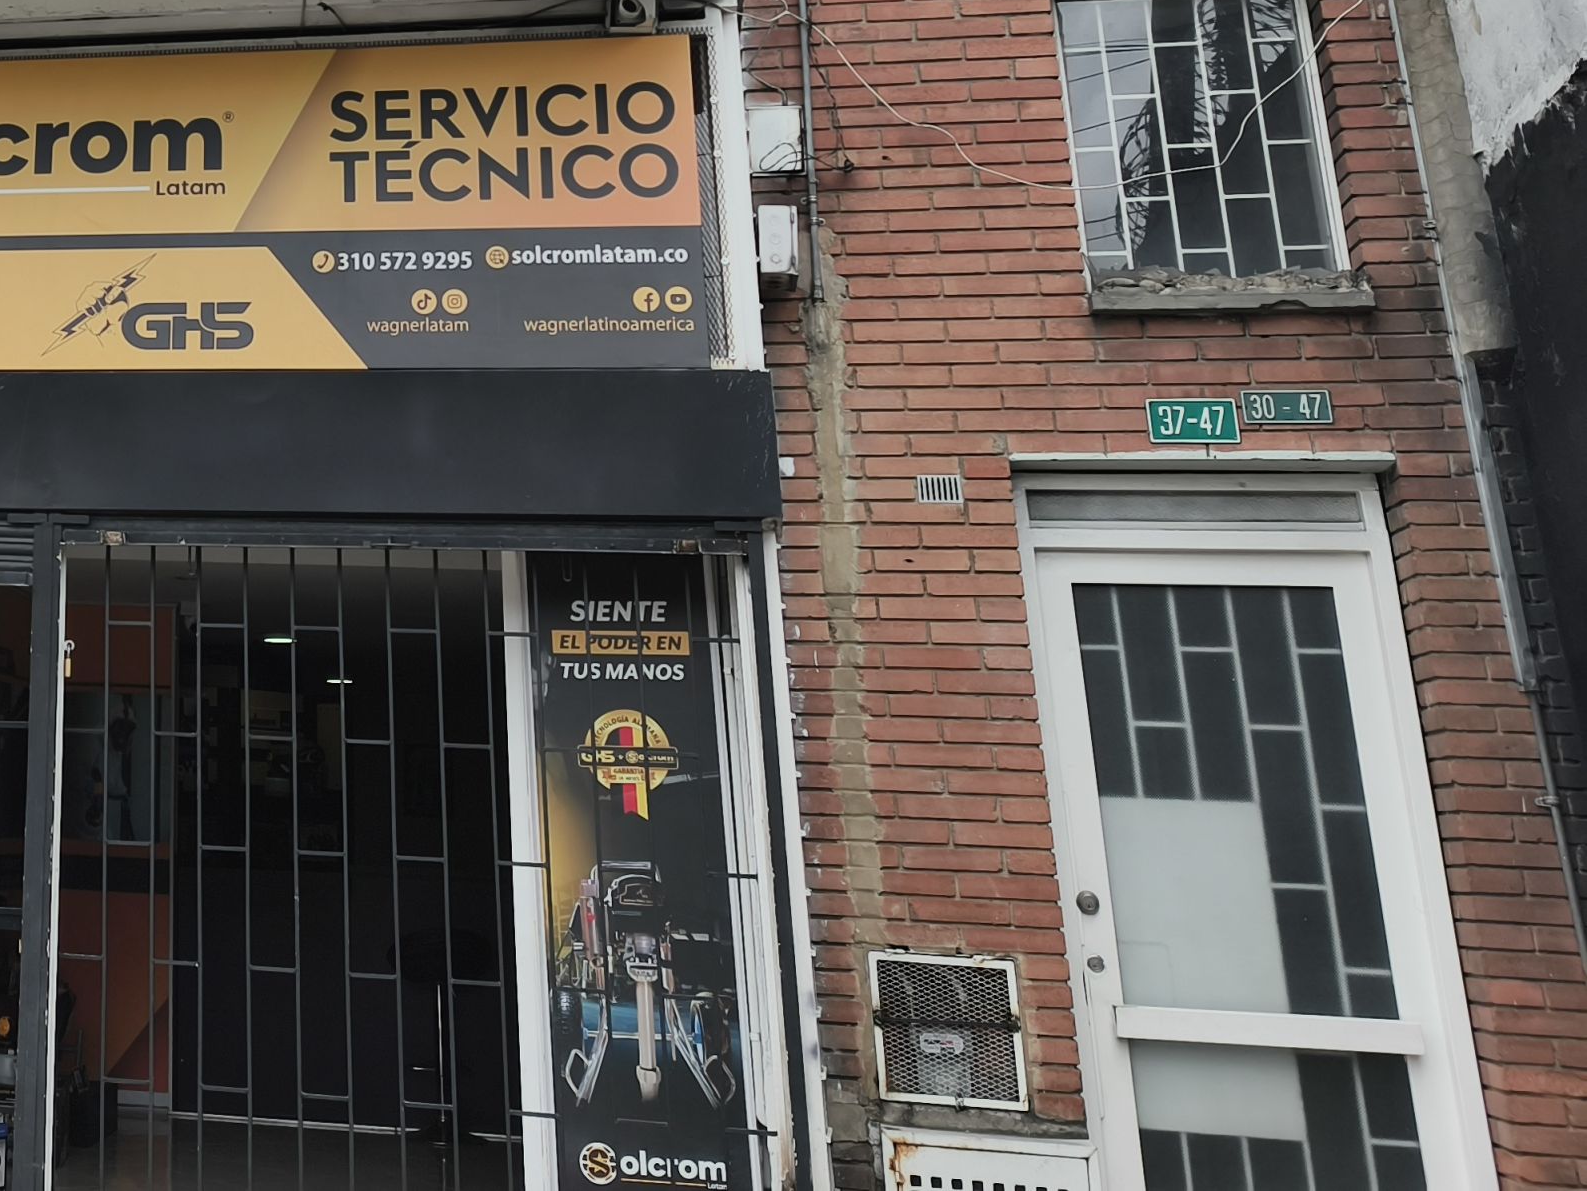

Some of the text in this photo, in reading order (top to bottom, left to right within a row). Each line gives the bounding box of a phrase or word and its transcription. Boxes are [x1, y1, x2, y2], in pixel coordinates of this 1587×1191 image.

[329, 80, 675, 142] SERVICIO
[329, 140, 679, 203] TÉCNICO
[155, 179, 226, 196] Latam
[337, 250, 473, 271] 310 572 9295
[511, 244, 689, 265] solcromlatam.co
[120, 301, 255, 351] GHS
[367, 317, 469, 336] wagnerlatam
[524, 316, 695, 335] wagnerlatinoamerica
[1158, 406, 1224, 436] 37-47
[570, 600, 667, 622] SIENTE
[559, 635, 580, 649] EL
[656, 636, 682, 650] EN
[560, 662, 685, 681] TUS MANOS
